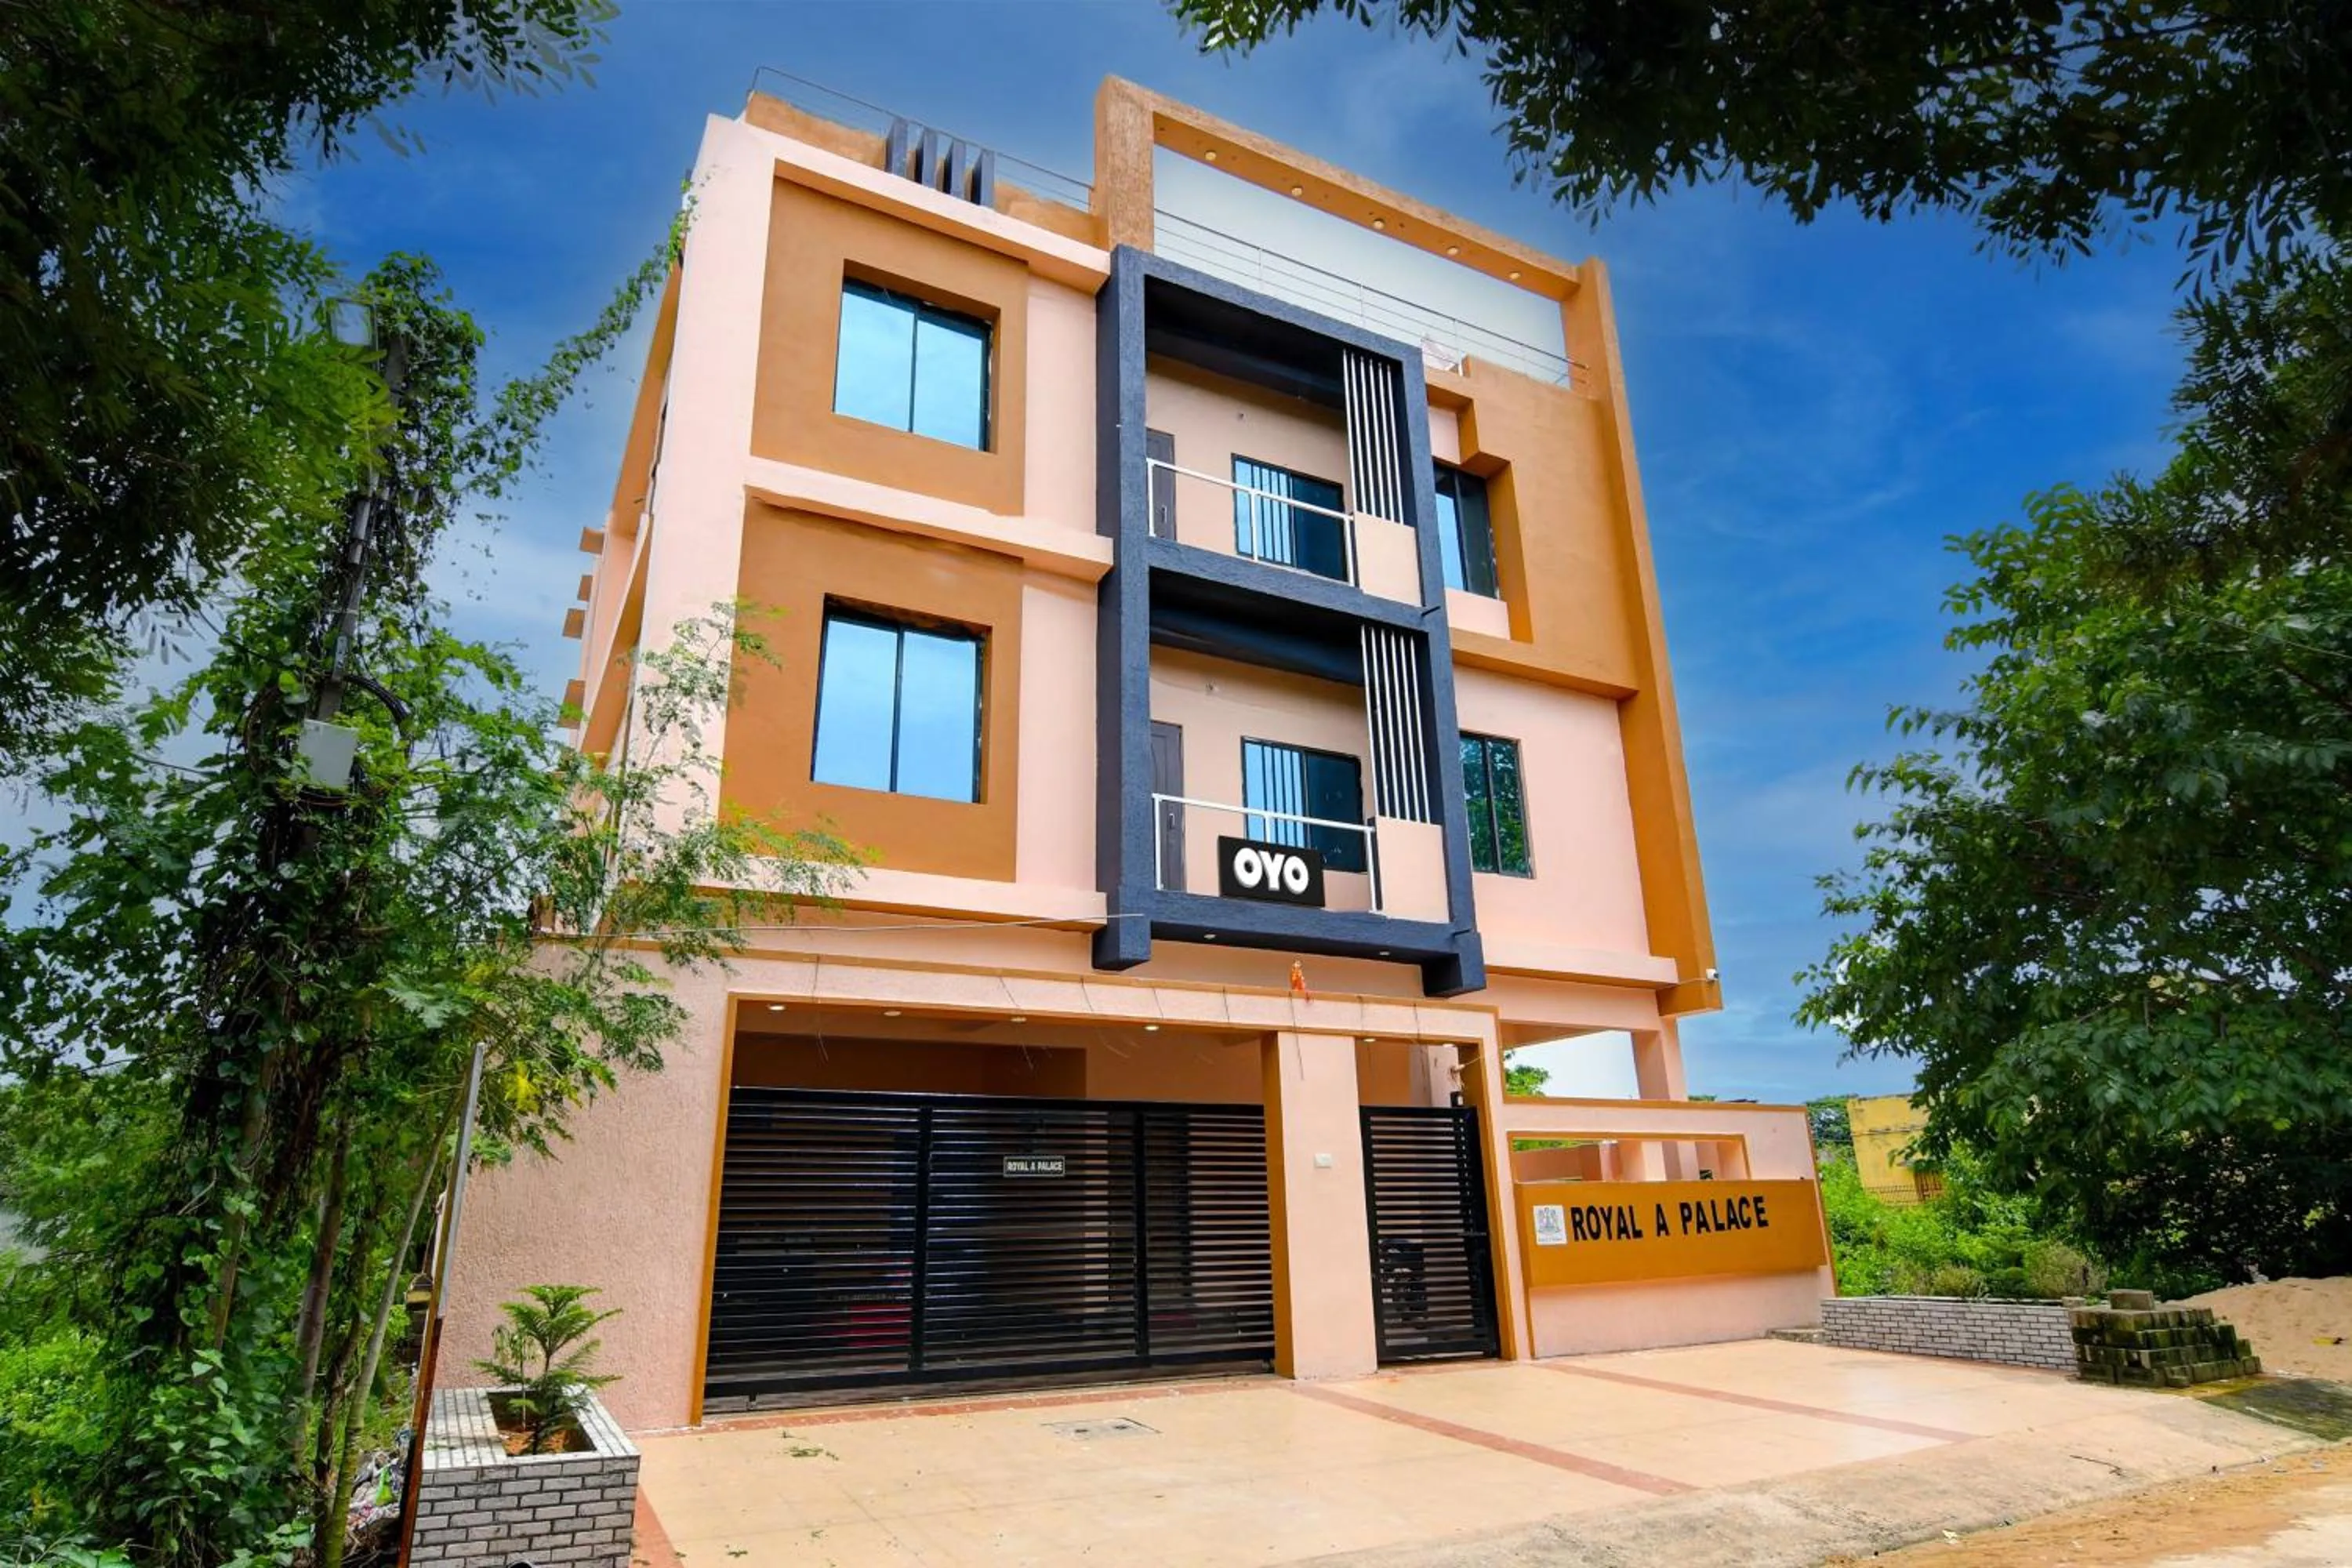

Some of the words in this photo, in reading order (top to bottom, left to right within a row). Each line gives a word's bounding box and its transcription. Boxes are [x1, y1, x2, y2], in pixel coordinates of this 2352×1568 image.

[1234, 848, 1309, 895] OYO
[1007, 1161, 1029, 1171] ROYAL
[1029, 1161, 1035, 1172] A
[1037, 1161, 1062, 1172] PALACE
[1570, 1205, 1643, 1241] ROYAL
[1656, 1203, 1669, 1237] A
[1679, 1196, 1769, 1236] PALACE
